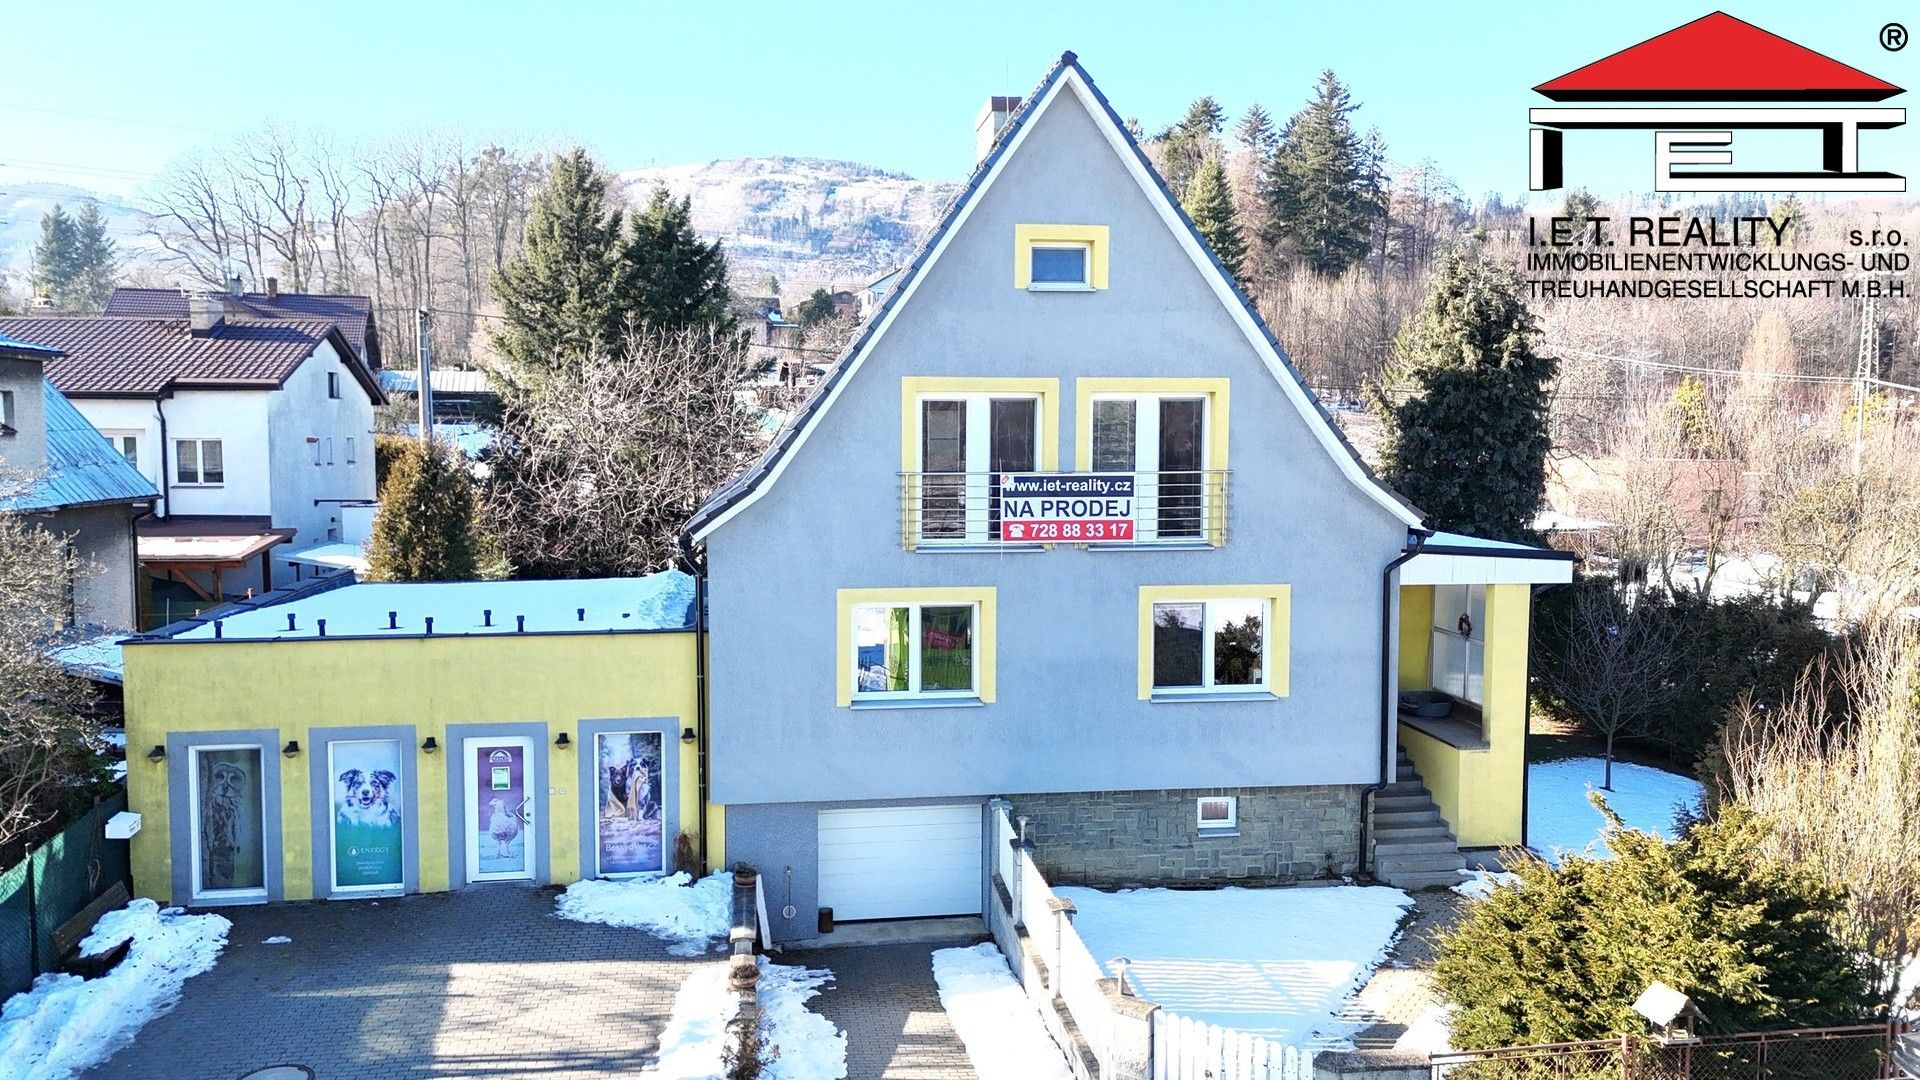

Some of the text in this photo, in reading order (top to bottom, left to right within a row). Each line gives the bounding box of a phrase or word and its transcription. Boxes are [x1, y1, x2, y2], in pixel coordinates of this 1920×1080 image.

[1004, 500, 1131, 518] NA PRODEJ
[1030, 523, 1128, 538] 728 88 33 17
